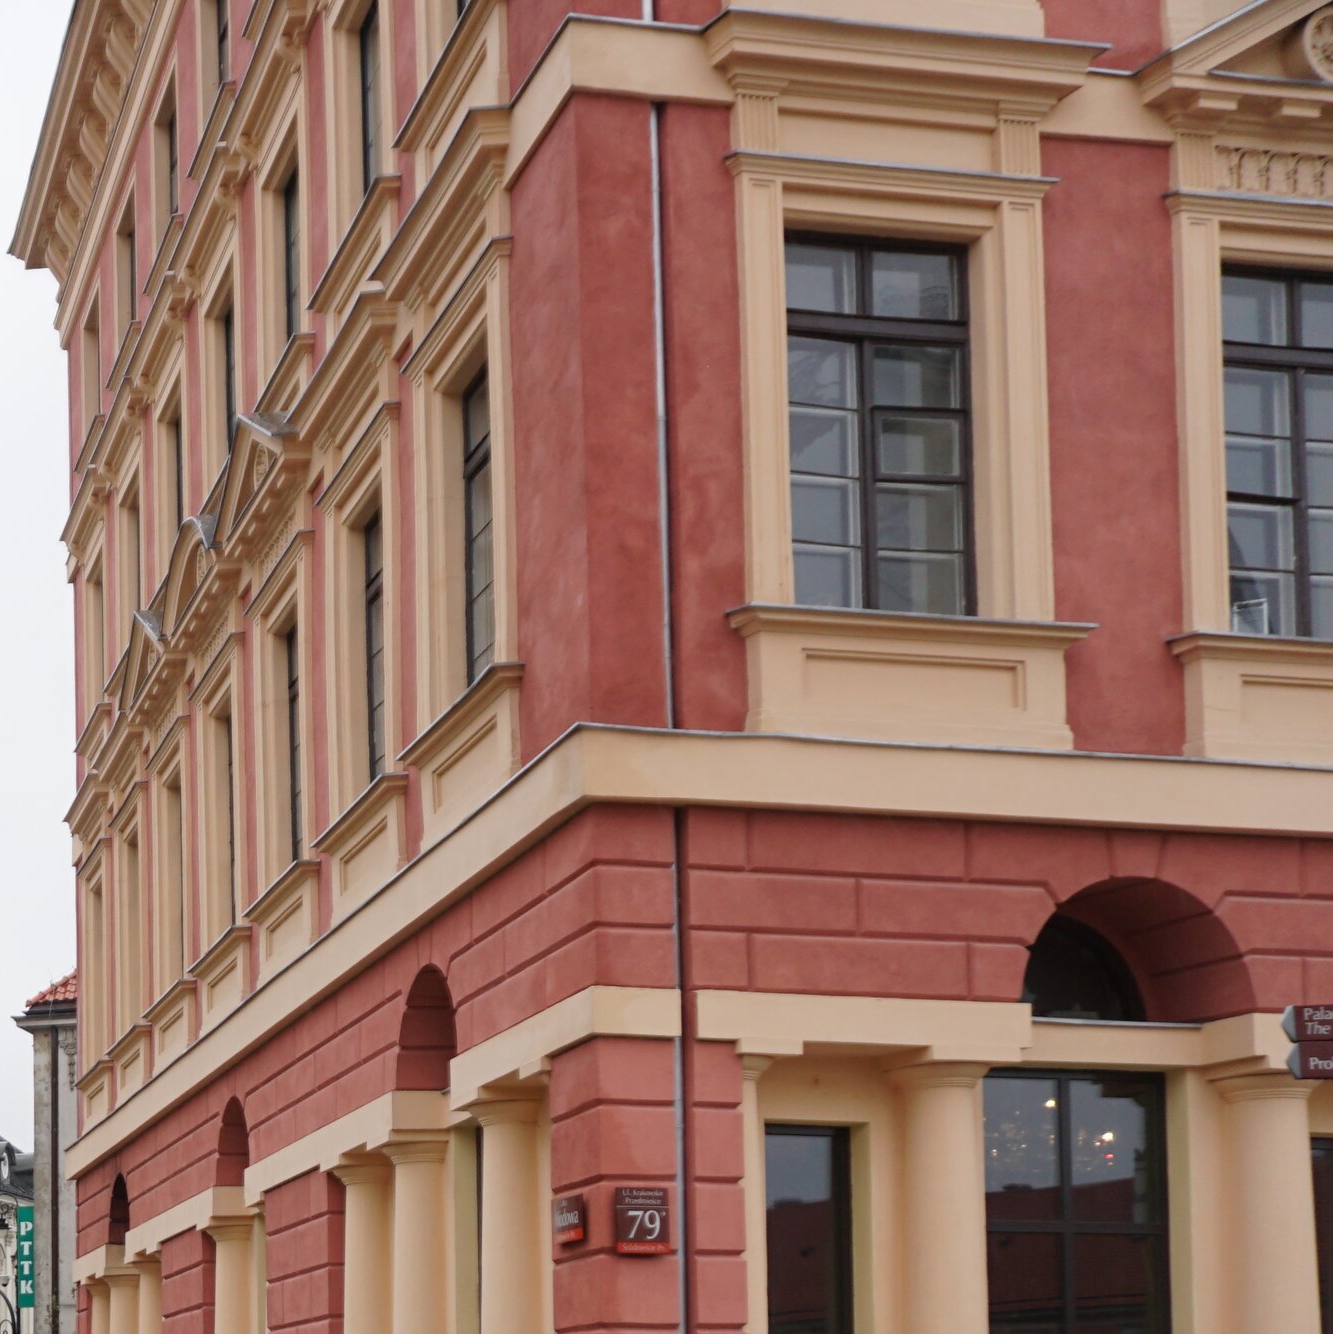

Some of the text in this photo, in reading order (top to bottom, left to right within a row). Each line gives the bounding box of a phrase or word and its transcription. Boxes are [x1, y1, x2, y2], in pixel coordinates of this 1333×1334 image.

[1305, 1021, 1331, 1035] The
[1309, 1056, 1333, 1070] Pro
[627, 1209, 661, 1240] 79
[20, 1221, 33, 1295] PTTK
